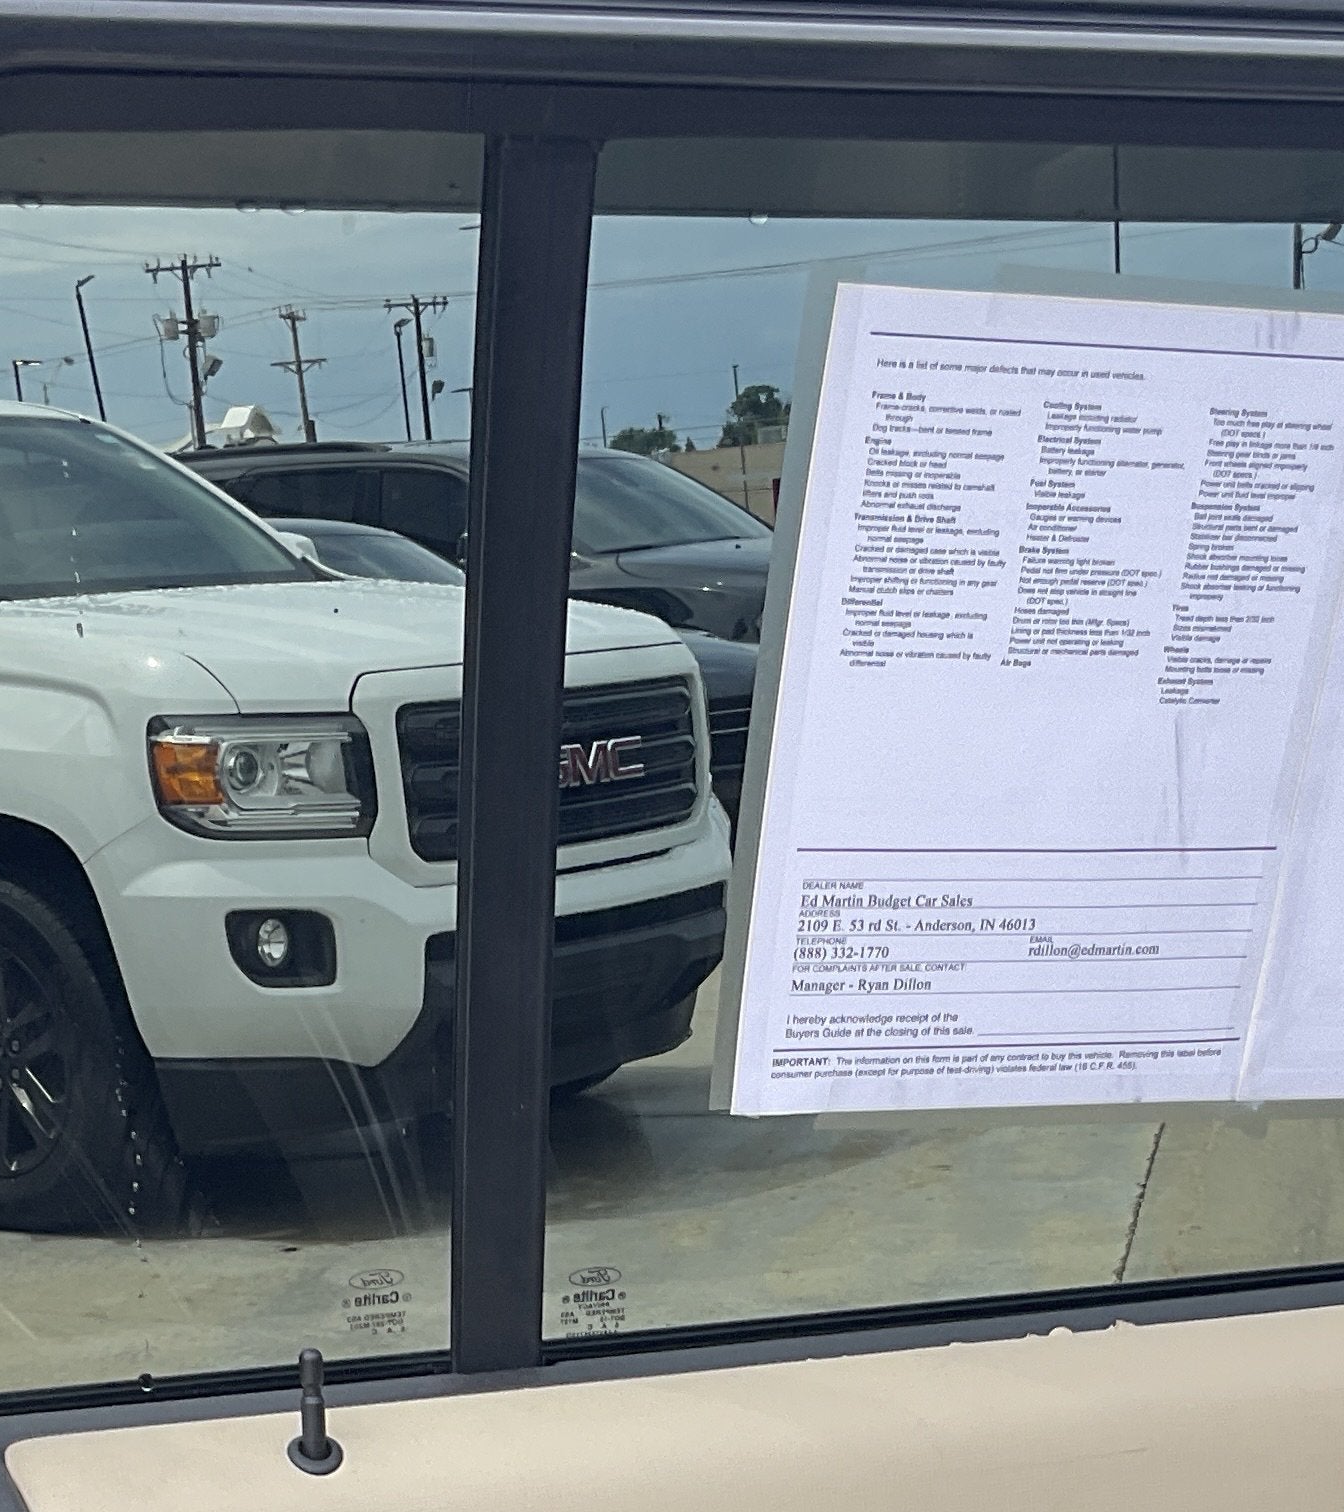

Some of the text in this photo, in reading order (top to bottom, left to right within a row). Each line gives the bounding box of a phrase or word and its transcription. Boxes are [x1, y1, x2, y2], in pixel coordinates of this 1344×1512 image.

[800, 895, 973, 910] Ed Martin Budget Car Sales
[797, 919, 828, 932] 2109
[848, 919, 865, 932] 53
[867, 919, 882, 932] rd
[913, 919, 976, 935] Anderson,
[978, 918, 996, 931] IN
[998, 918, 1036, 931] 46013
[793, 946, 889, 961] (888) 332-1770
[1028, 942, 1159, 959] rdillon@edmartin.com
[790, 979, 845, 994] Manager
[856, 979, 890, 994] Ryan
[892, 978, 931, 991] Dillon
